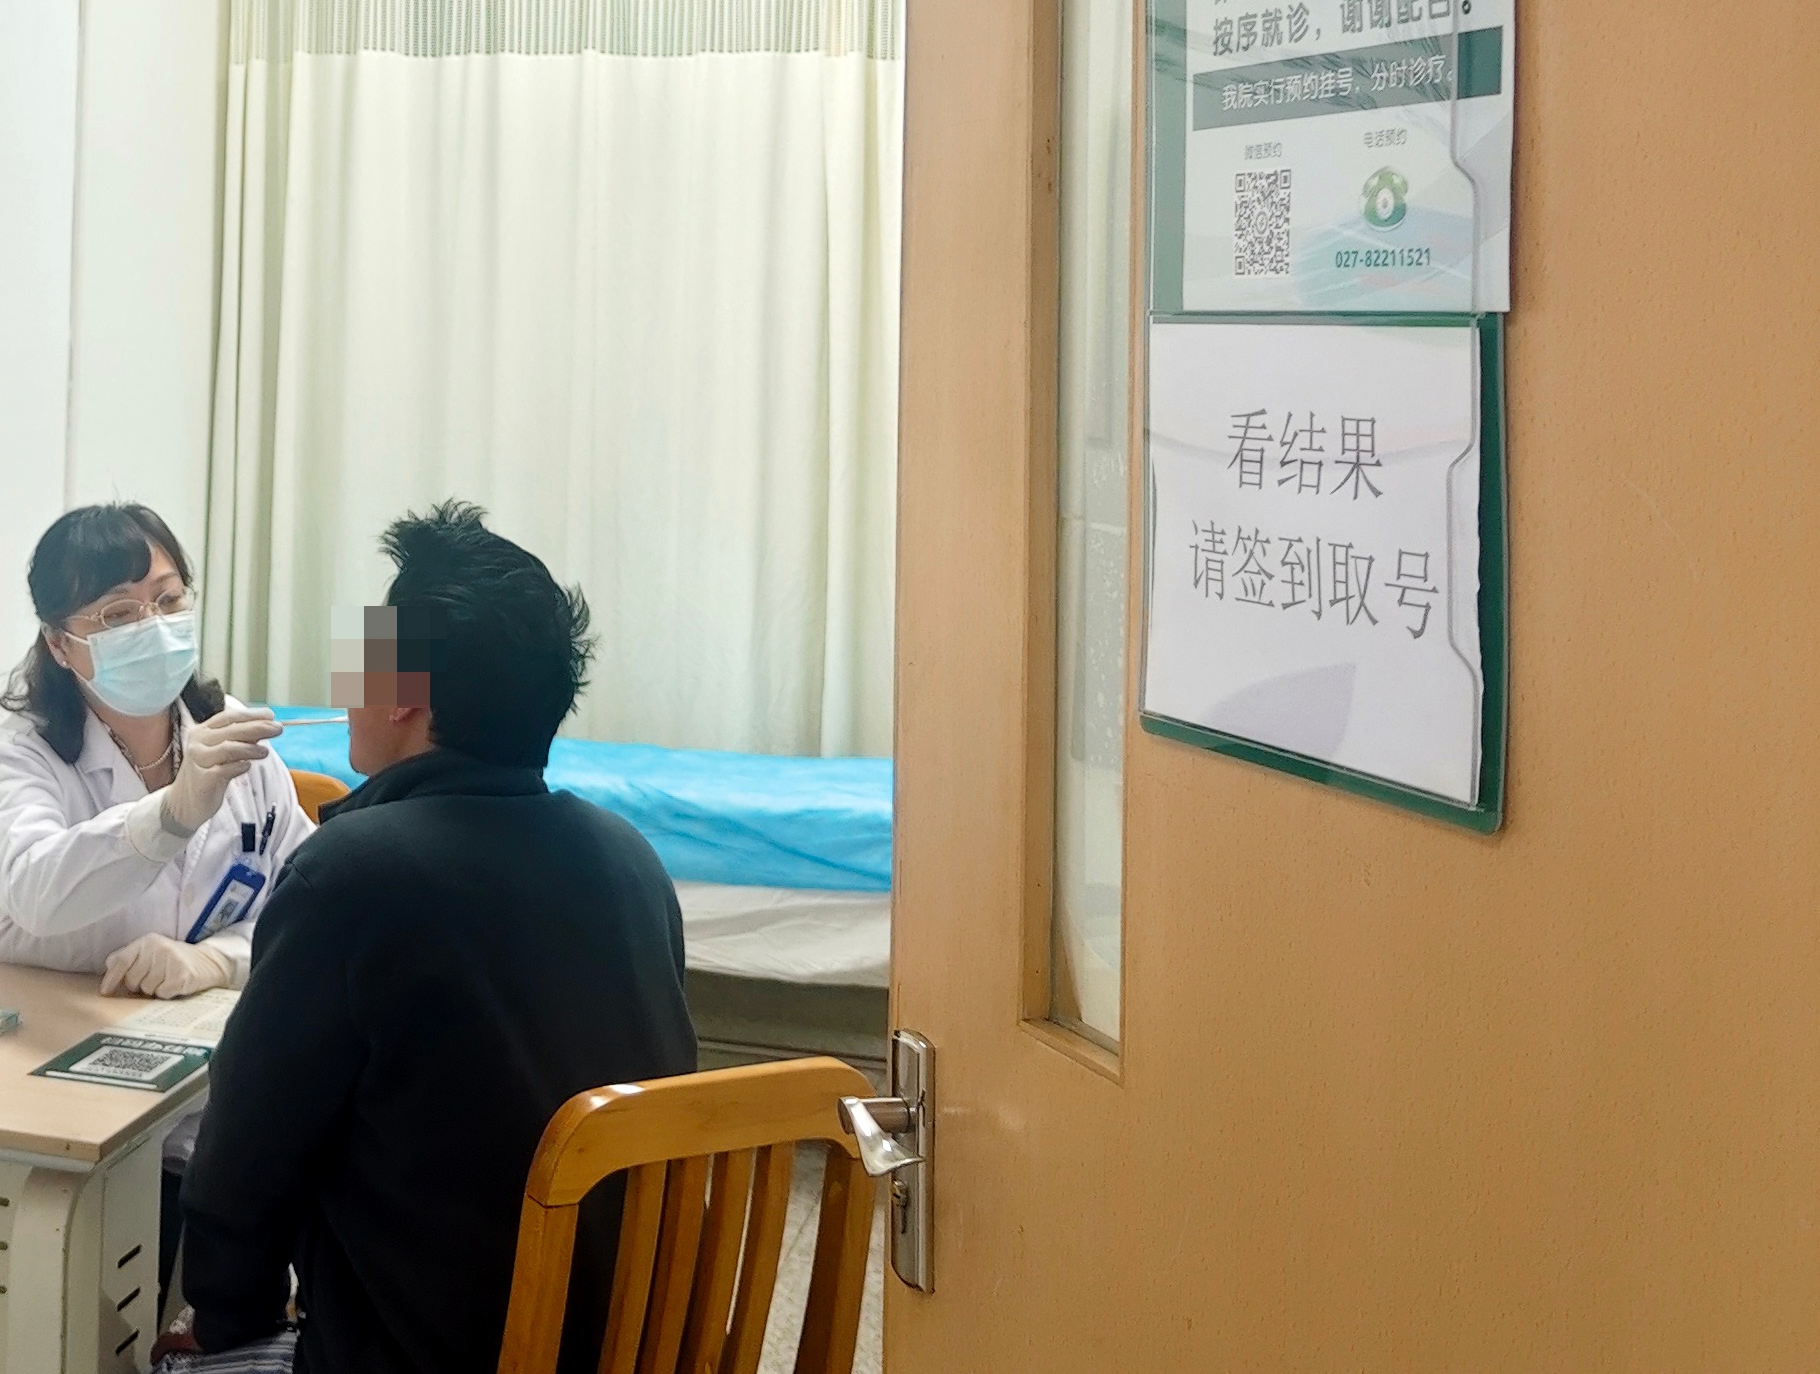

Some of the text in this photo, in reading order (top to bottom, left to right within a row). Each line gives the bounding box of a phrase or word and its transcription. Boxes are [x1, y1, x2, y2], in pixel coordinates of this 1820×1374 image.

[1364, 128, 1408, 148] 电话预约
[1335, 247, 1431, 268] 027-82211521
[1227, 408, 1384, 501] 看结果
[1189, 519, 1440, 640] 请签到取号
